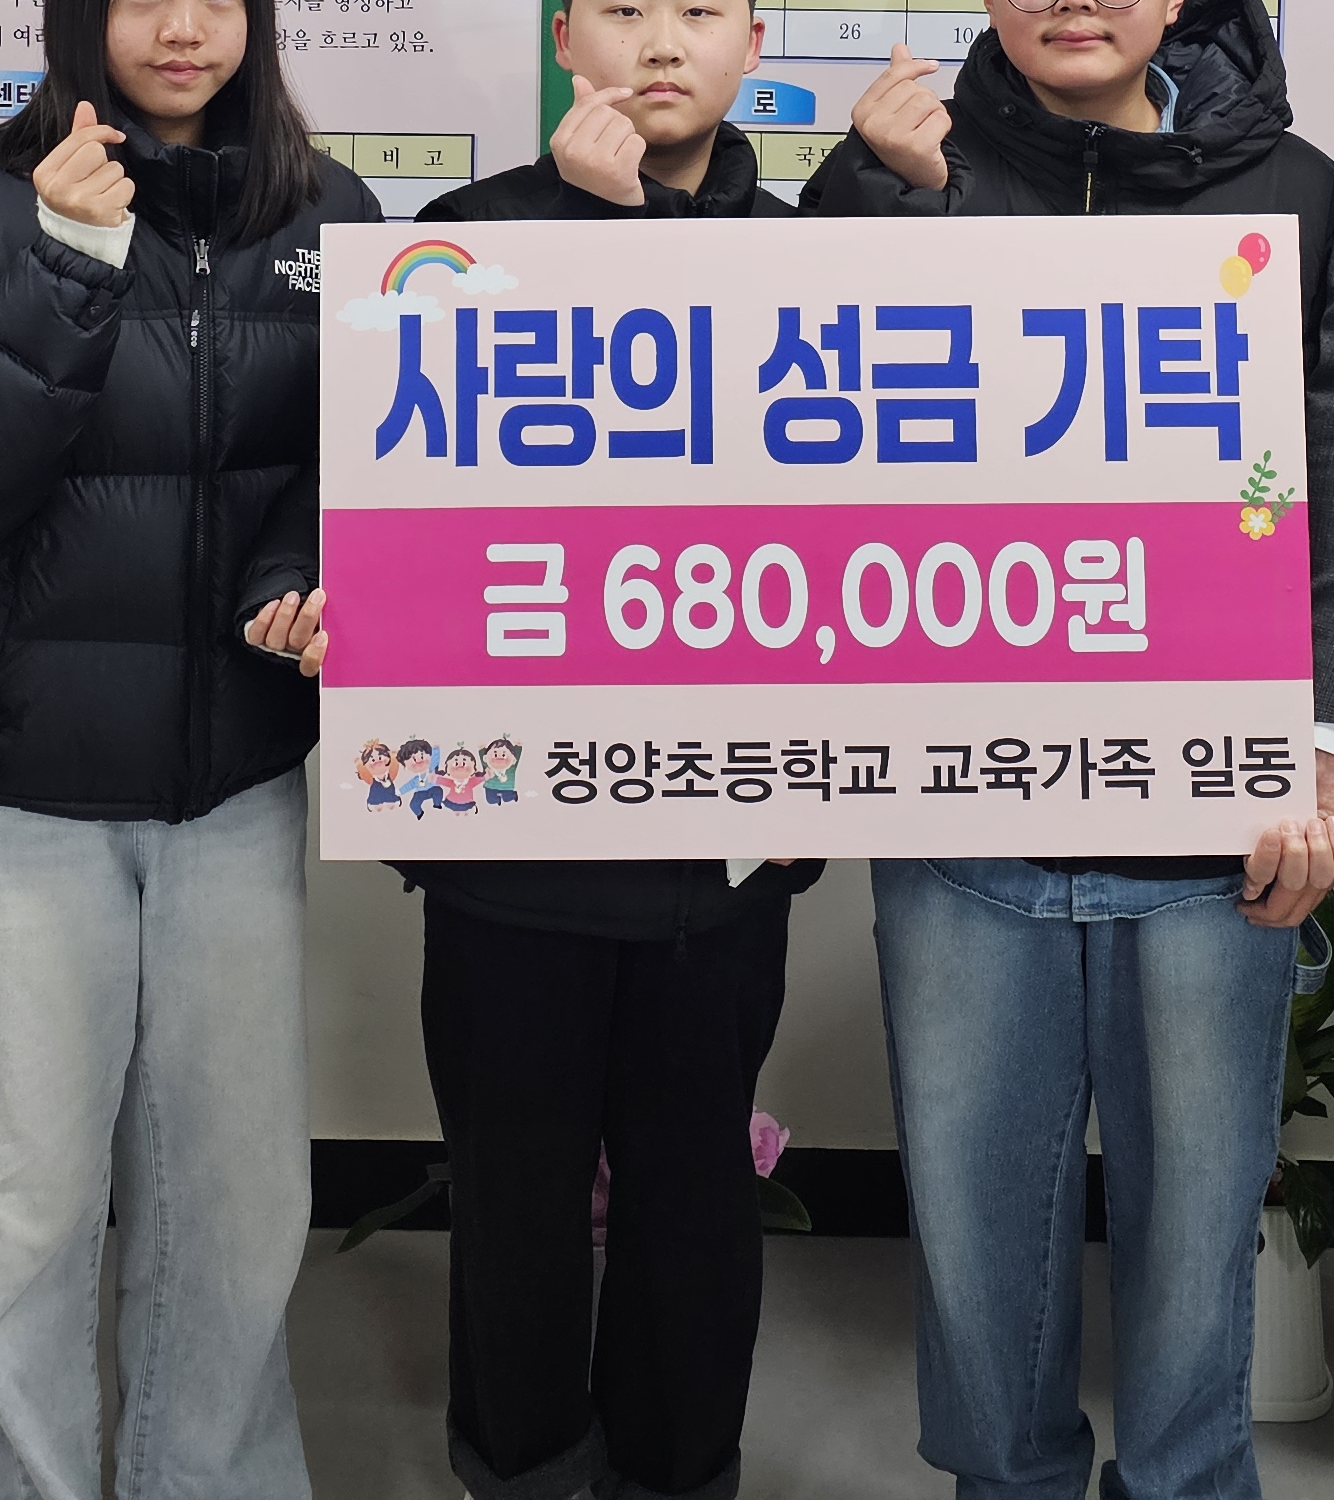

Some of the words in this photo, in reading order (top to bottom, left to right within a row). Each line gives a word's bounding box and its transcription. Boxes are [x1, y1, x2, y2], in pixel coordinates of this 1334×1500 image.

[318, 30, 380, 49] 흐르고
[389, 30, 434, 53] 있음.
[839, 22, 861, 40] 26
[294, 247, 322, 266] THE
[273, 259, 322, 280] NORTH
[287, 275, 322, 293] FACE
[373, 302, 715, 469] 사랑의
[757, 302, 981, 466] 성금
[1021, 300, 1250, 464] 기탁
[482, 541, 569, 659] 금
[601, 535, 1151, 666] 680,000원
[541, 736, 897, 807] 청양초등학교
[918, 734, 1157, 804] 교육가족
[1180, 733, 1298, 801] 일동
